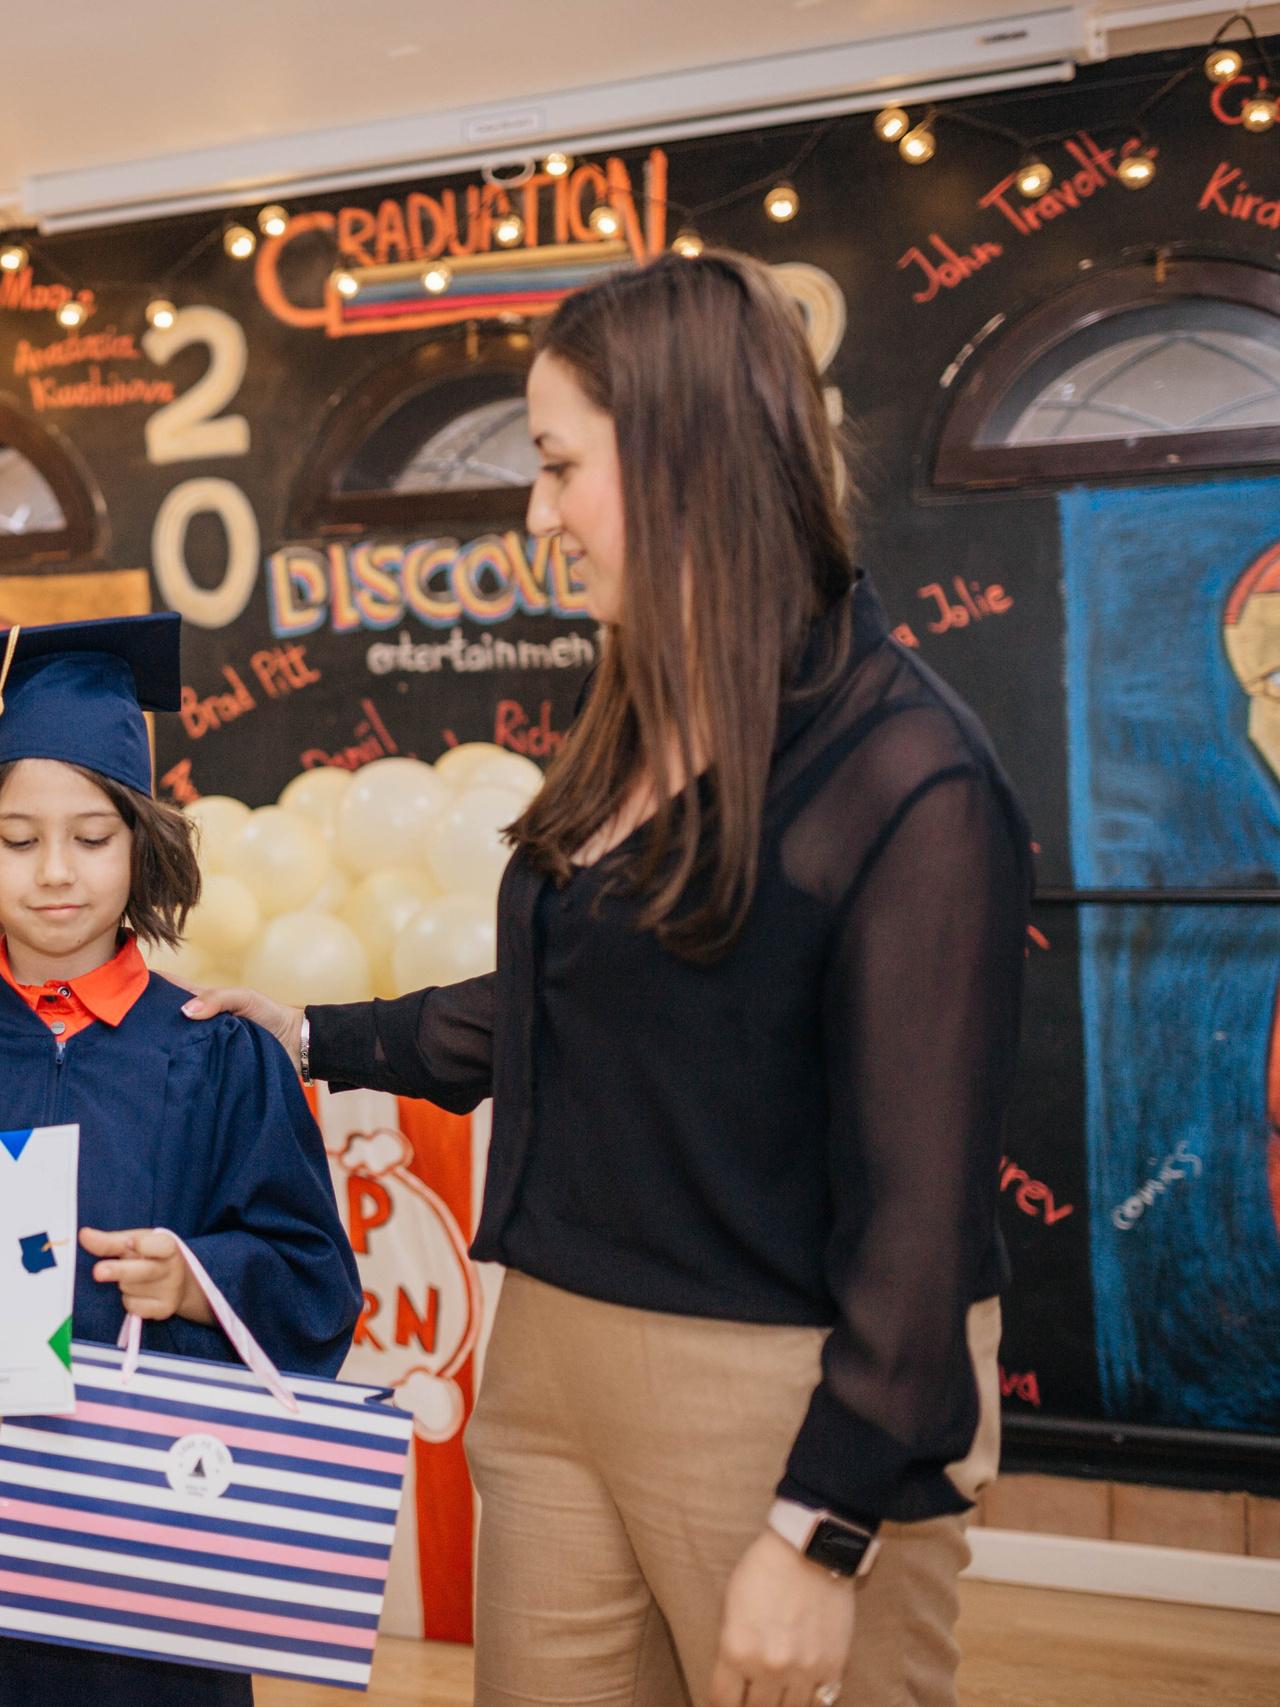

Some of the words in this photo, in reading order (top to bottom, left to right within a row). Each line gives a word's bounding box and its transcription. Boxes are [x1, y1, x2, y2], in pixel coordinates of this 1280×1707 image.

[255, 148, 668, 337] GRADUATION
[897, 233, 1004, 303] John
[919, 575, 1014, 634] Jolie
[366, 626, 596, 676] entertainmen
